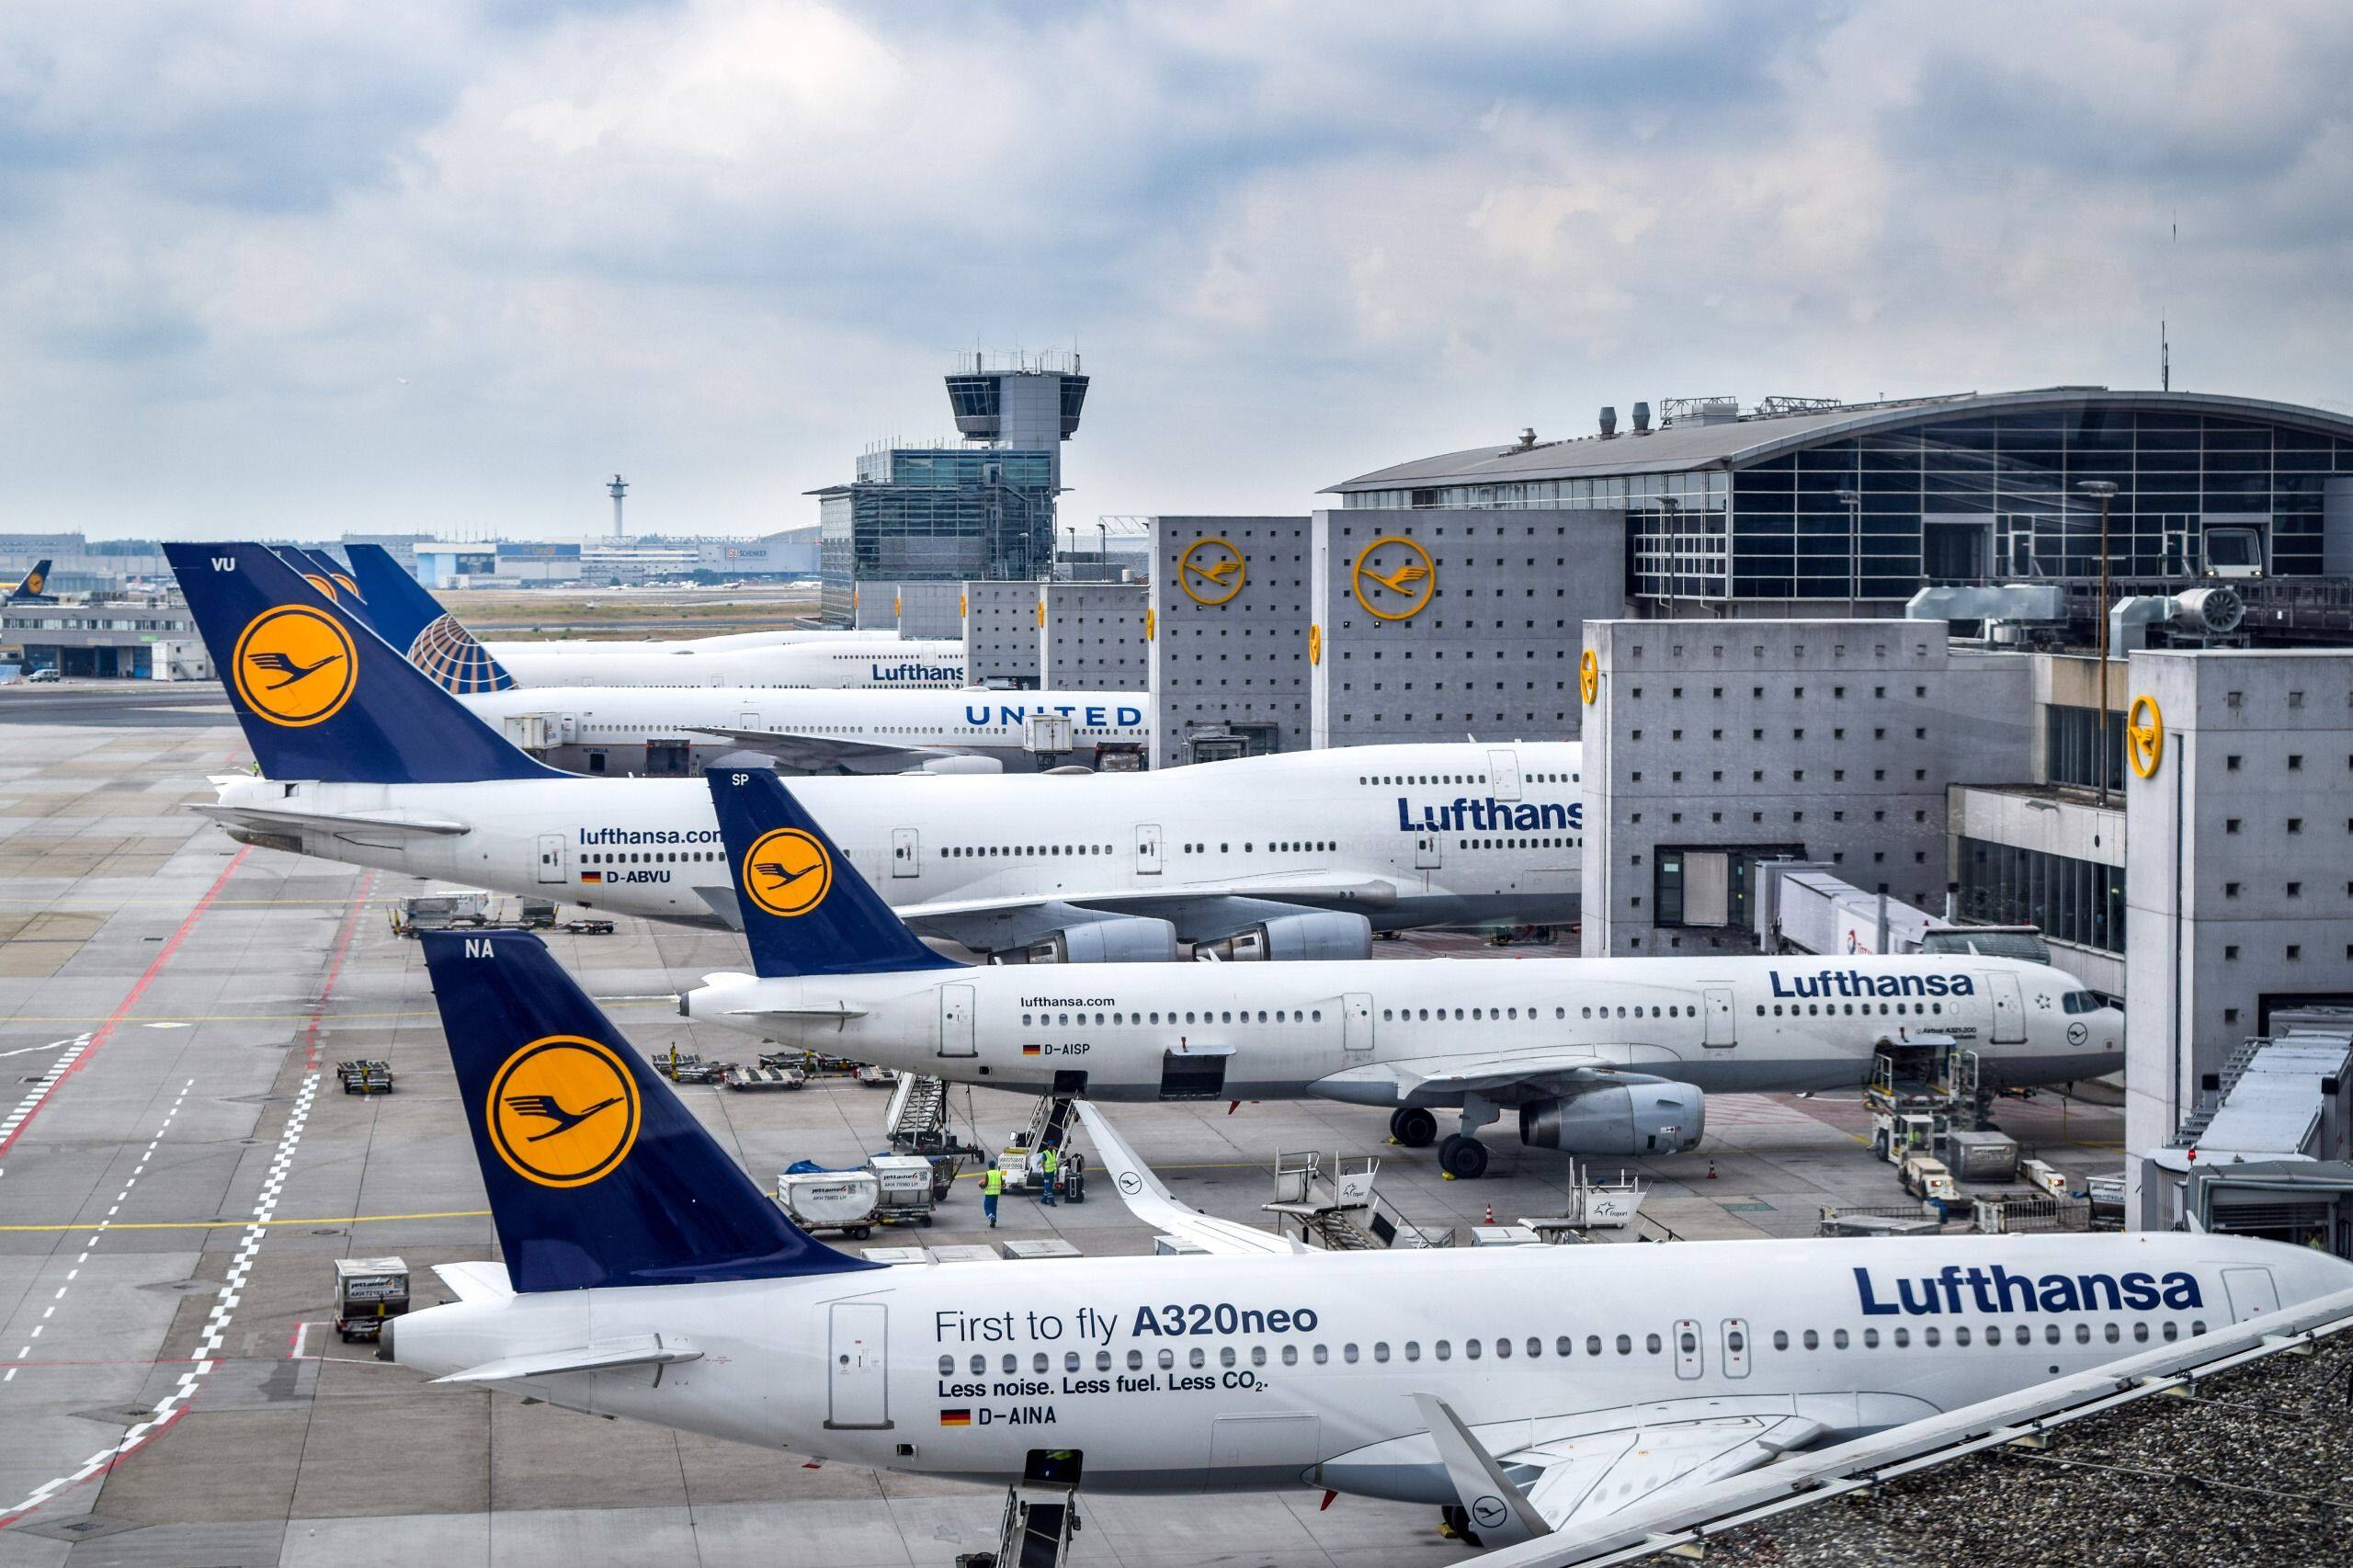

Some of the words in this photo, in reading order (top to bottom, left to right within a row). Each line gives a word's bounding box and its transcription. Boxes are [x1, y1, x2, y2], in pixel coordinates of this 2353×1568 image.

[210, 557, 235, 572] VU
[872, 663, 963, 681] Lufthans
[732, 773, 749, 786] SP
[1397, 797, 1583, 832] Lufthans
[607, 870, 671, 883] D-ABVU
[465, 938, 494, 959] NA
[1768, 970, 1975, 998] Lufthansa
[1020, 996, 1115, 1007] lufthansa.com
[1044, 1043, 1090, 1055] D-AISP
[1853, 1265, 2204, 1316] Lufthansa
[936, 1311, 1016, 1342] First
[1026, 1311, 1063, 1340] to
[1075, 1307, 1119, 1346] fly
[1131, 1302, 1318, 1337] A320neo
[938, 1380, 987, 1398] Less
[993, 1378, 1055, 1397] noise.
[1063, 1377, 1110, 1394] Less
[1116, 1373, 1161, 1392] fuel.
[1168, 1373, 1216, 1391] Less
[978, 1405, 1057, 1426] D-AINA
